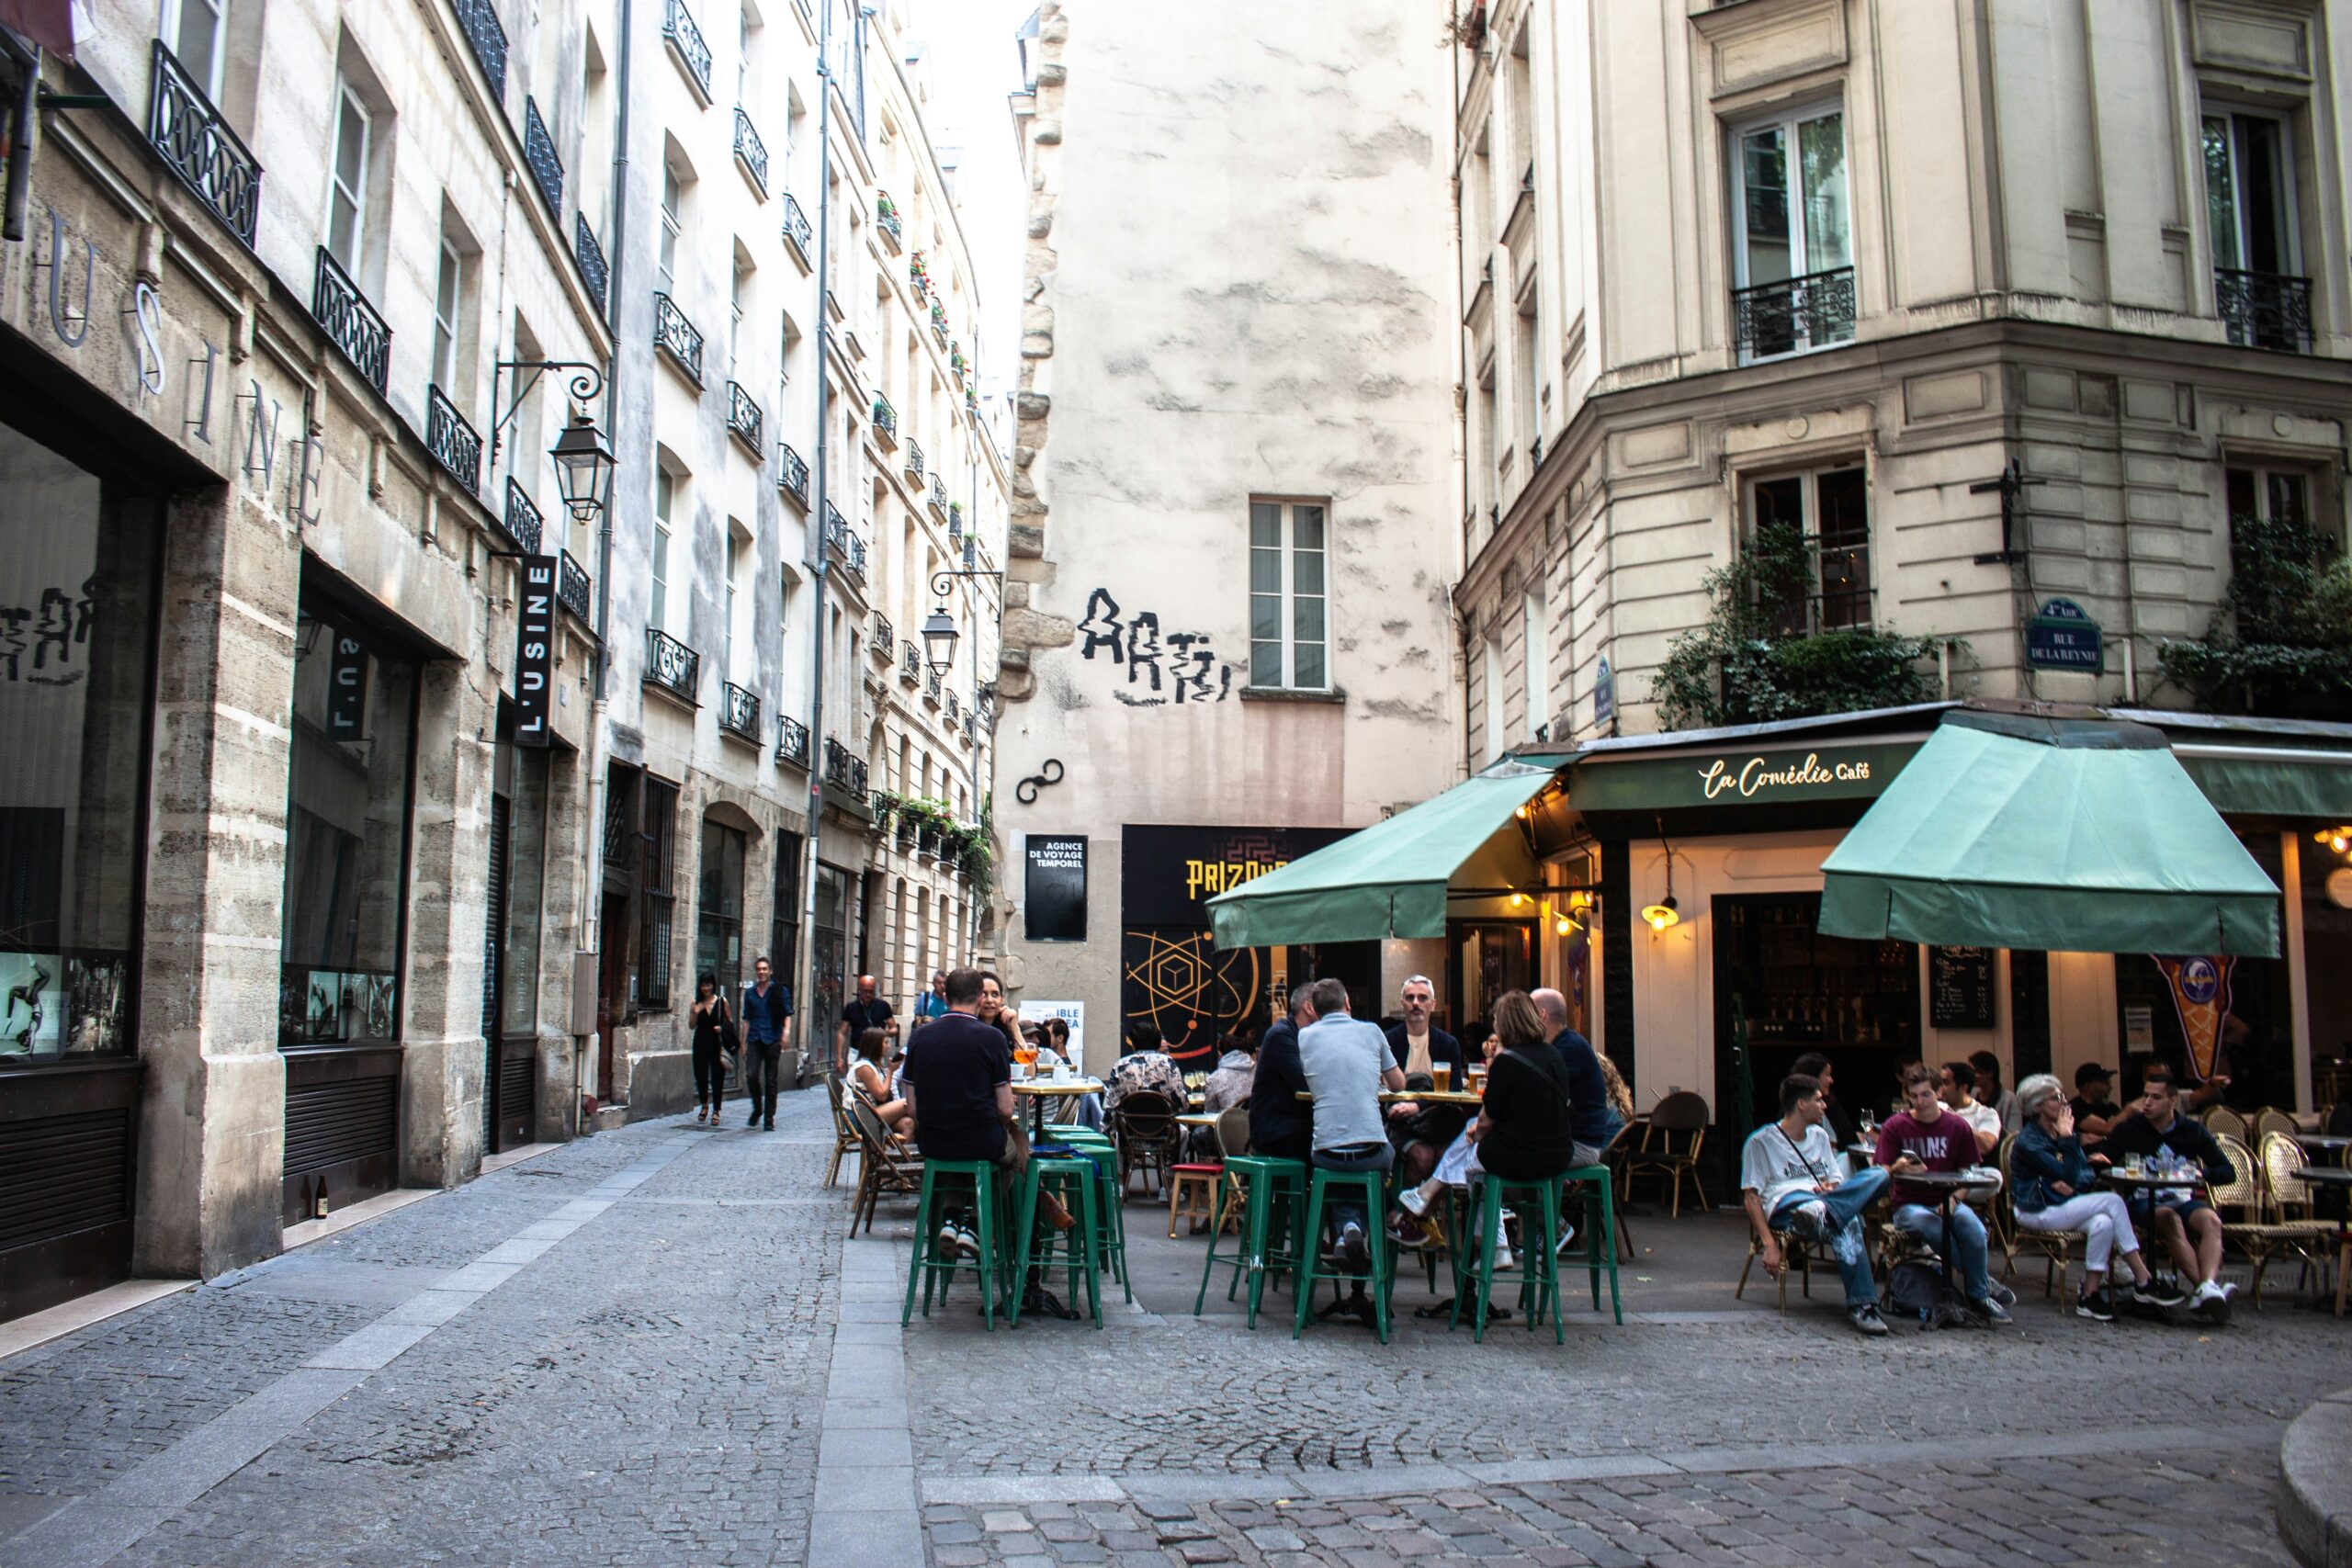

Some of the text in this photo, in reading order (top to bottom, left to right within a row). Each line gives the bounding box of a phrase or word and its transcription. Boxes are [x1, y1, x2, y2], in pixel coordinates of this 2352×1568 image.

[2053, 633, 2075, 645] RUE
[521, 567, 549, 731] L'USINE
[1698, 753, 1871, 798] La Comédie Café
[1029, 851, 1083, 859] DE VOYAGE
[1046, 842, 1082, 851] AGENCE
[1036, 859, 1083, 868] TEMPOREL
[1186, 860, 1287, 899] PRIZO
[1902, 1136, 1948, 1158] VANS
